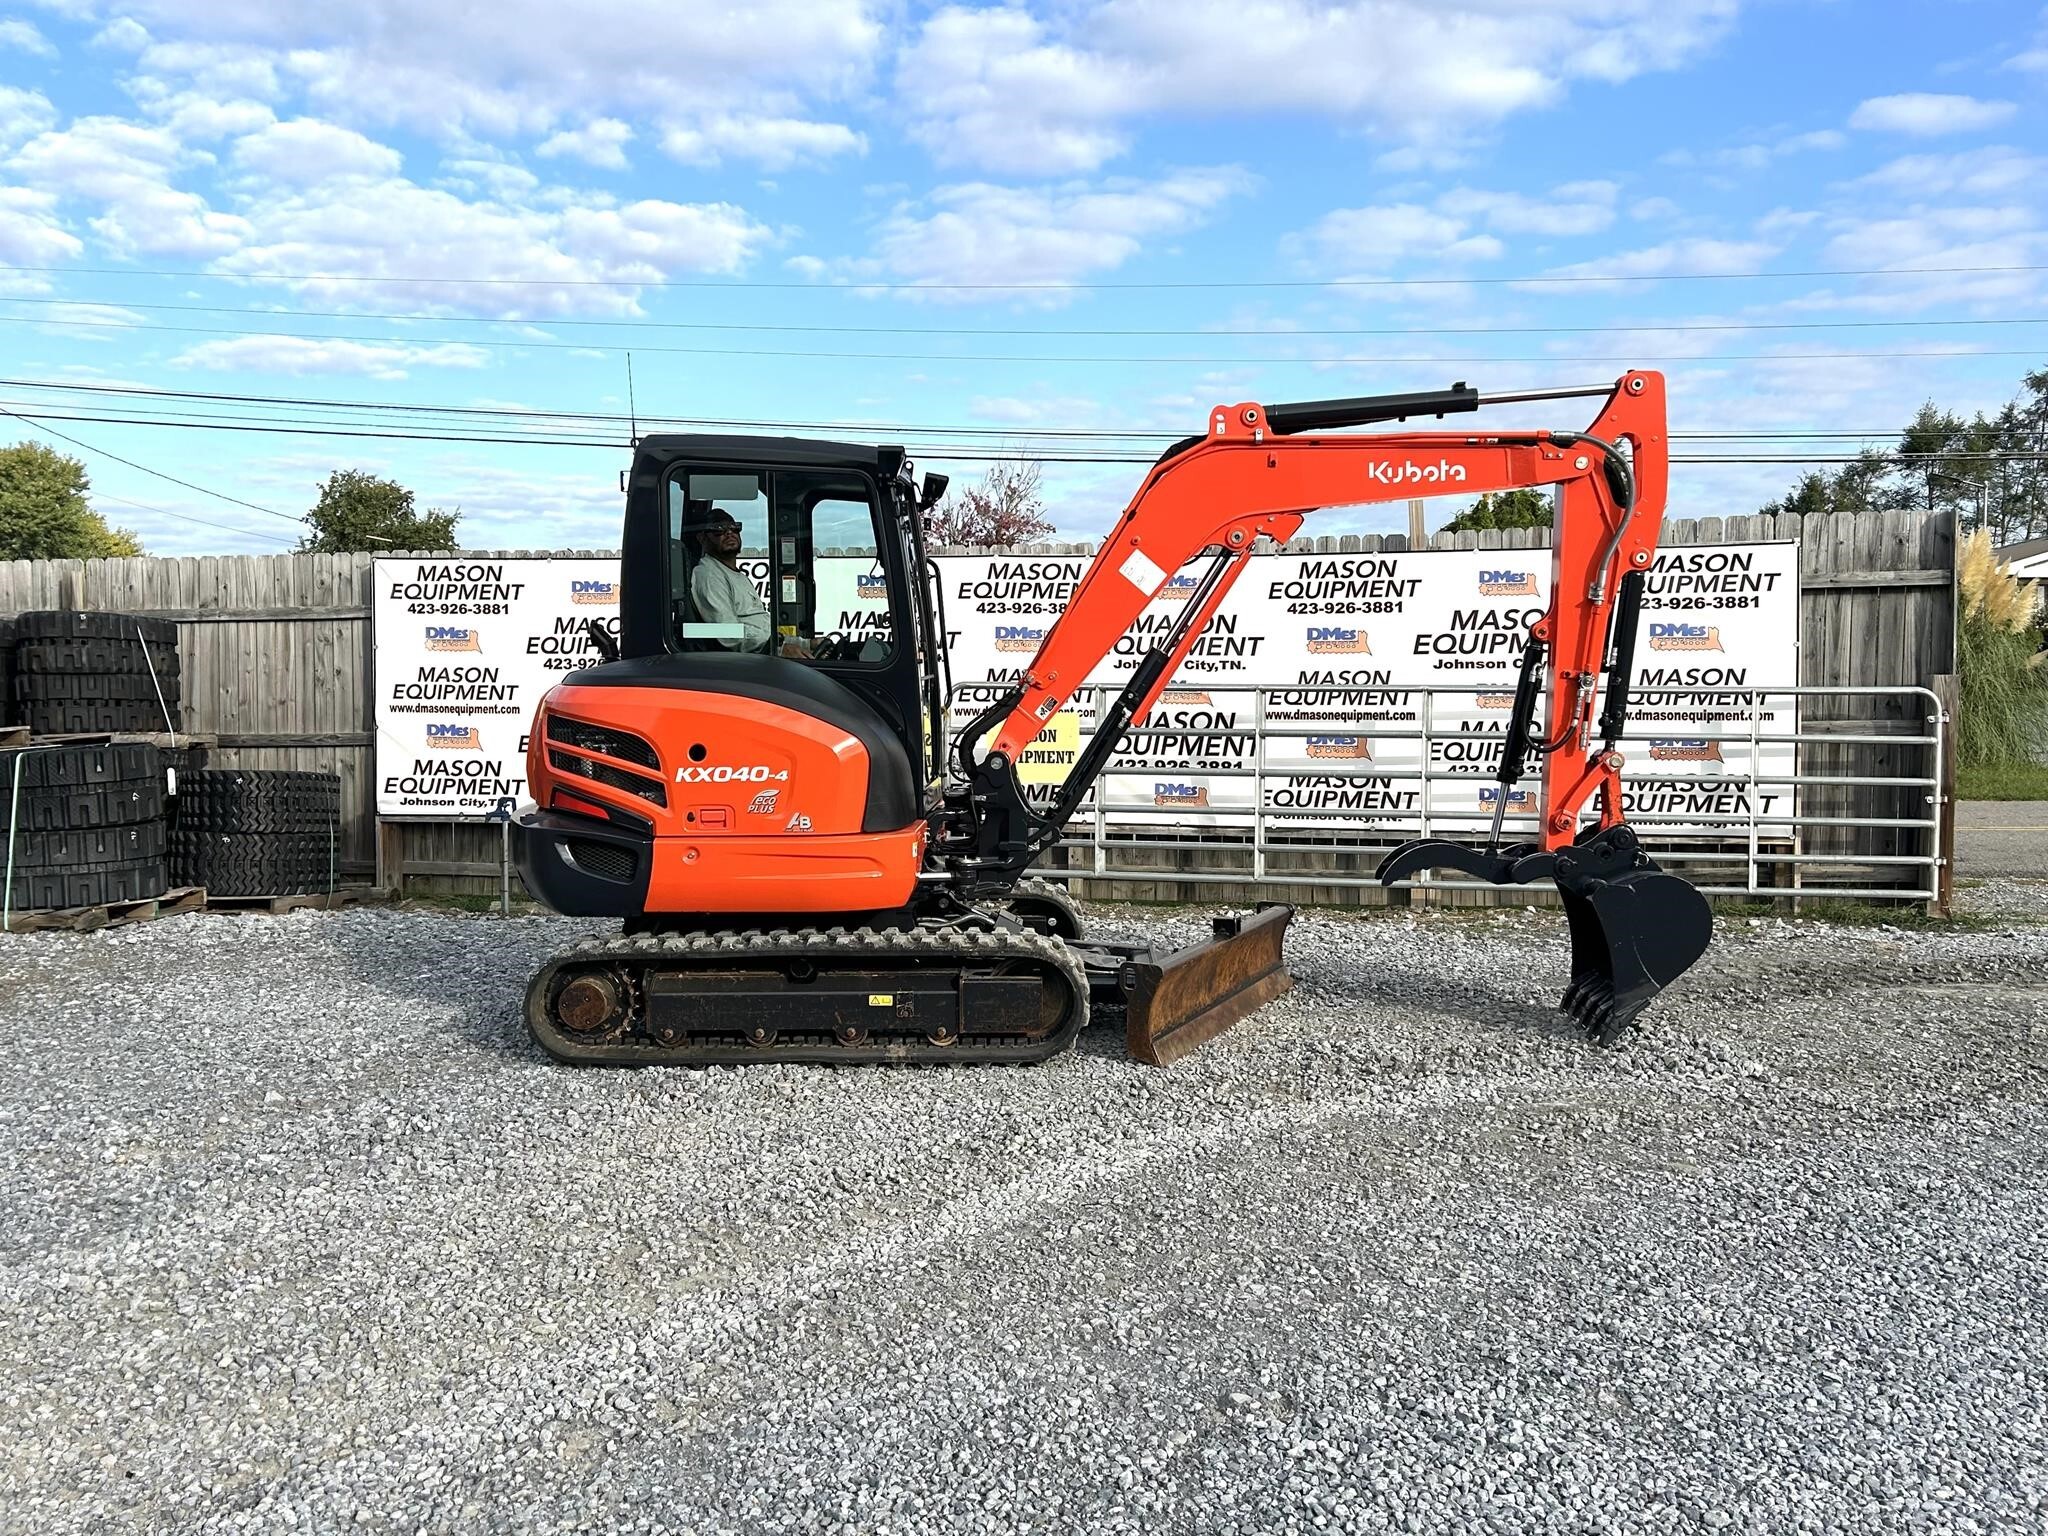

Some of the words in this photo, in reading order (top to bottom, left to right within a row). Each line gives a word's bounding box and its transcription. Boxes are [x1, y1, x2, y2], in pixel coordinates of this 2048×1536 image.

[1368, 458, 1467, 484] Kubota
[417, 565, 503, 582] MASON
[987, 563, 1082, 580] MASON
[1299, 560, 1398, 579] MASON
[1479, 570, 1526, 583] DMes
[571, 580, 612, 592] DMes
[857, 575, 884, 587] DM
[1168, 575, 1198, 588] Mes
[1643, 573, 1781, 593] UIPMENT
[390, 583, 525, 601] EQUIPMENT
[958, 582, 1080, 600] EQUIPME
[1267, 579, 1423, 600] EQUIPMENT
[407, 603, 510, 616] 423-926-3881
[976, 602, 1069, 614] 423-926-38
[1287, 601, 1404, 615] 423-926-3881
[1640, 596, 1760, 610] 23-926-3881
[1129, 614, 1238, 634] MAON
[1450, 609, 1545, 630] MASO
[425, 627, 469, 639] DMes
[995, 626, 1042, 639] DMes
[1306, 627, 1357, 640] DMes
[1650, 623, 1706, 637] DMes
[1413, 633, 1530, 655] EQUIPM
[1184, 660, 1247, 672] City,TN.
[1433, 659, 1507, 670] Johnson
[418, 667, 499, 683] MASON
[1298, 669, 1392, 686] MASON
[1639, 669, 1747, 686] MASON
[393, 684, 519, 700] EQUIPMENT
[1268, 690, 1411, 706] EQUIPMENT
[1627, 692, 1769, 706] QUIPMENT
[389, 703, 521, 717] www.dmasonequipment.com
[1265, 708, 1416, 722] www.dmasonequipment.com
[1623, 709, 1775, 724] w.dmasonequipment.com
[426, 723, 469, 736] DMes
[1115, 735, 1257, 757] QUIPMENT
[1018, 750, 1075, 764] IPMENT
[412, 759, 502, 777] MASON
[675, 765, 789, 784] KX040-4
[384, 778, 526, 796] EQUIPMENT
[1155, 783, 1198, 796] DMes
[400, 798, 456, 807] Johnson
[459, 798, 498, 809] City,T
[755, 796, 777, 805] eco
[747, 804, 775, 814] PLUS
